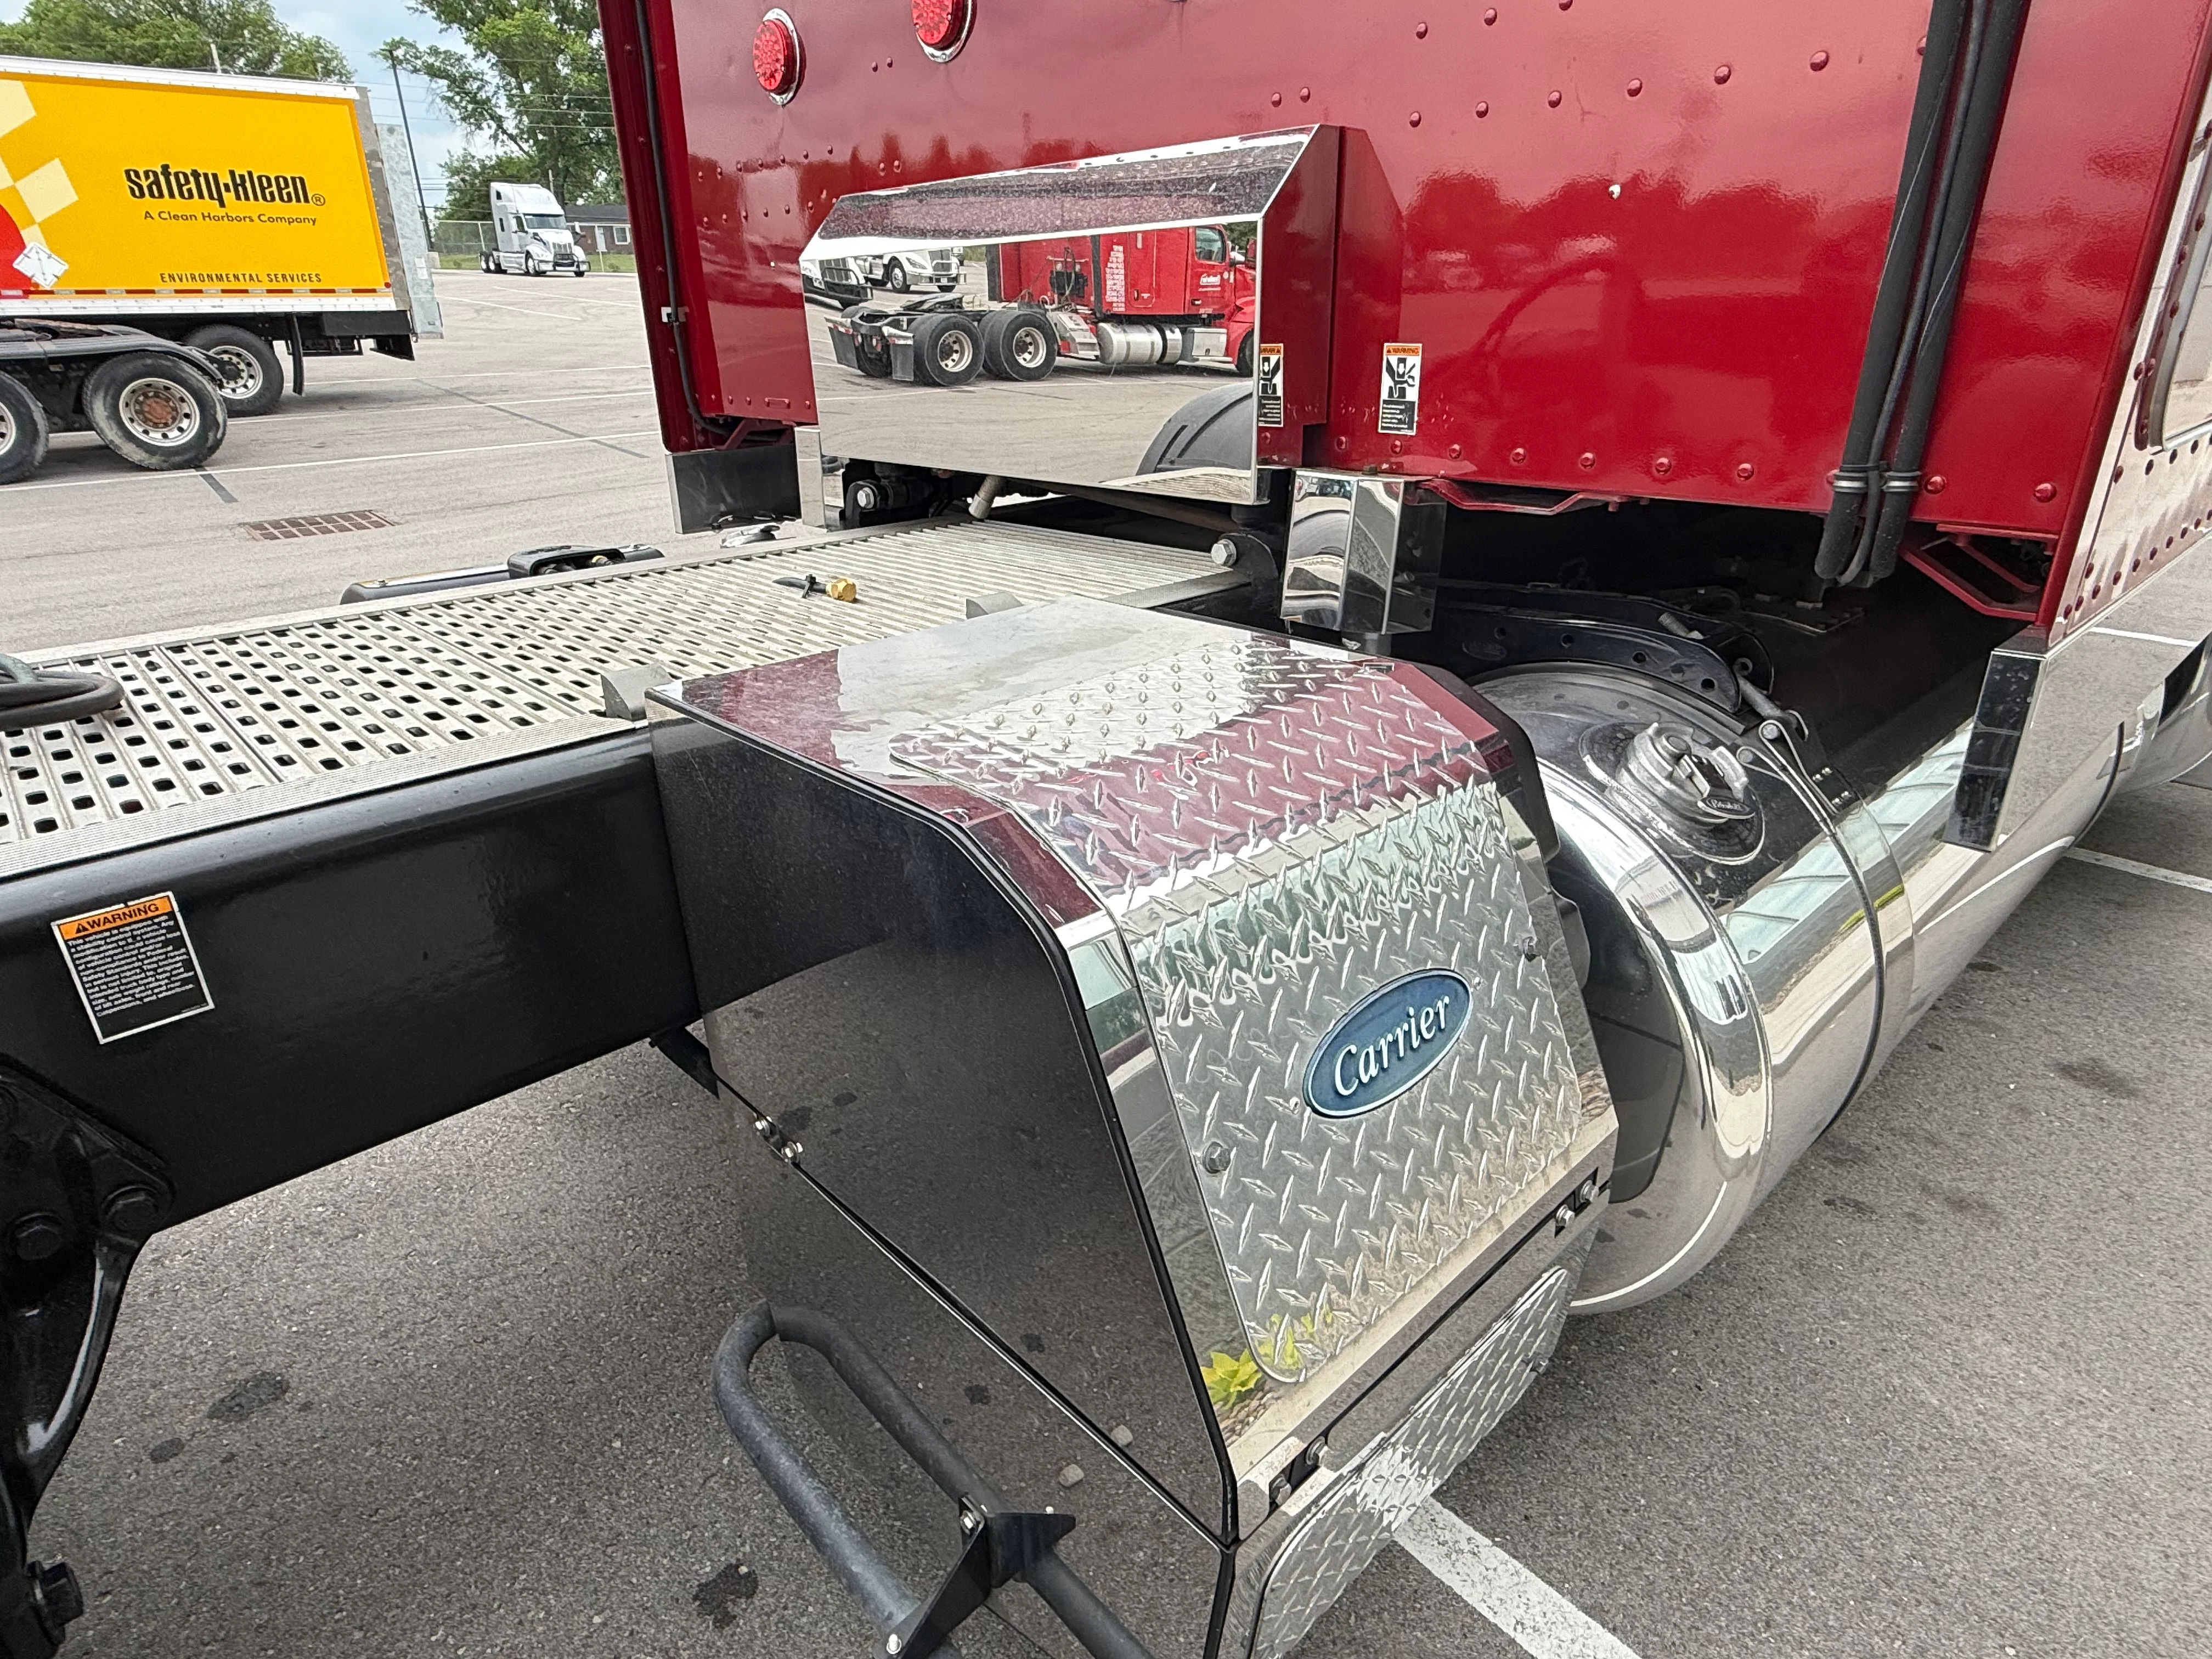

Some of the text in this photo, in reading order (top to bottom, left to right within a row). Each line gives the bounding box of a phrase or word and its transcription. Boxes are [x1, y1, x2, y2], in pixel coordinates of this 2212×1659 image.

[144, 211, 317, 225] A Clean Harbors Company
[160, 273, 322, 283] ENVIRONMENTAL SERVICES
[86, 903, 159, 929] WARNING
[1335, 995, 1450, 1097] Carrier
